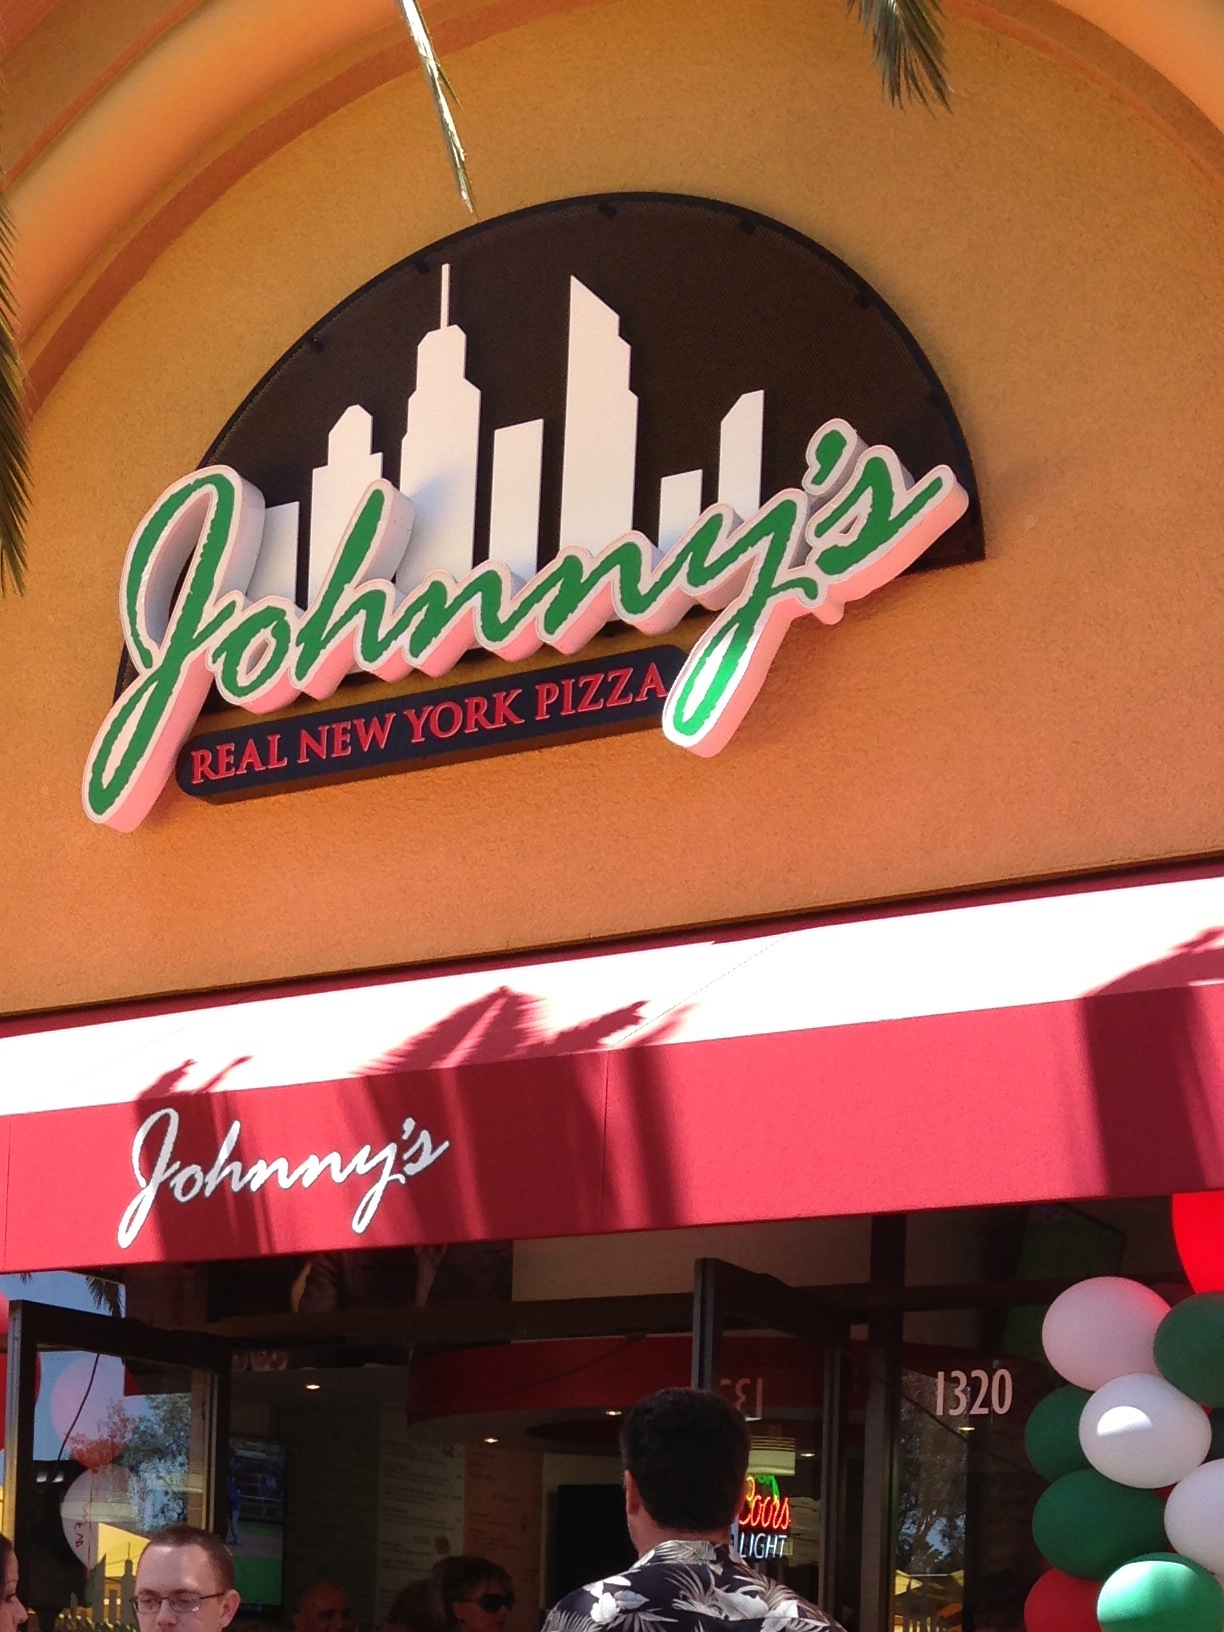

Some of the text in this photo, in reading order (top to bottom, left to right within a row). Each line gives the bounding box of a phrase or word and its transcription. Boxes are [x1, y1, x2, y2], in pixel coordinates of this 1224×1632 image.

[82, 417, 964, 828] Johnny's
[190, 661, 672, 785] REAL NEW YORK PIZZA
[117, 1107, 450, 1250] Johnny's
[936, 1368, 1013, 1416] 1320
[739, 1476, 791, 1530] Coors
[739, 1532, 788, 1560] LIGHT
